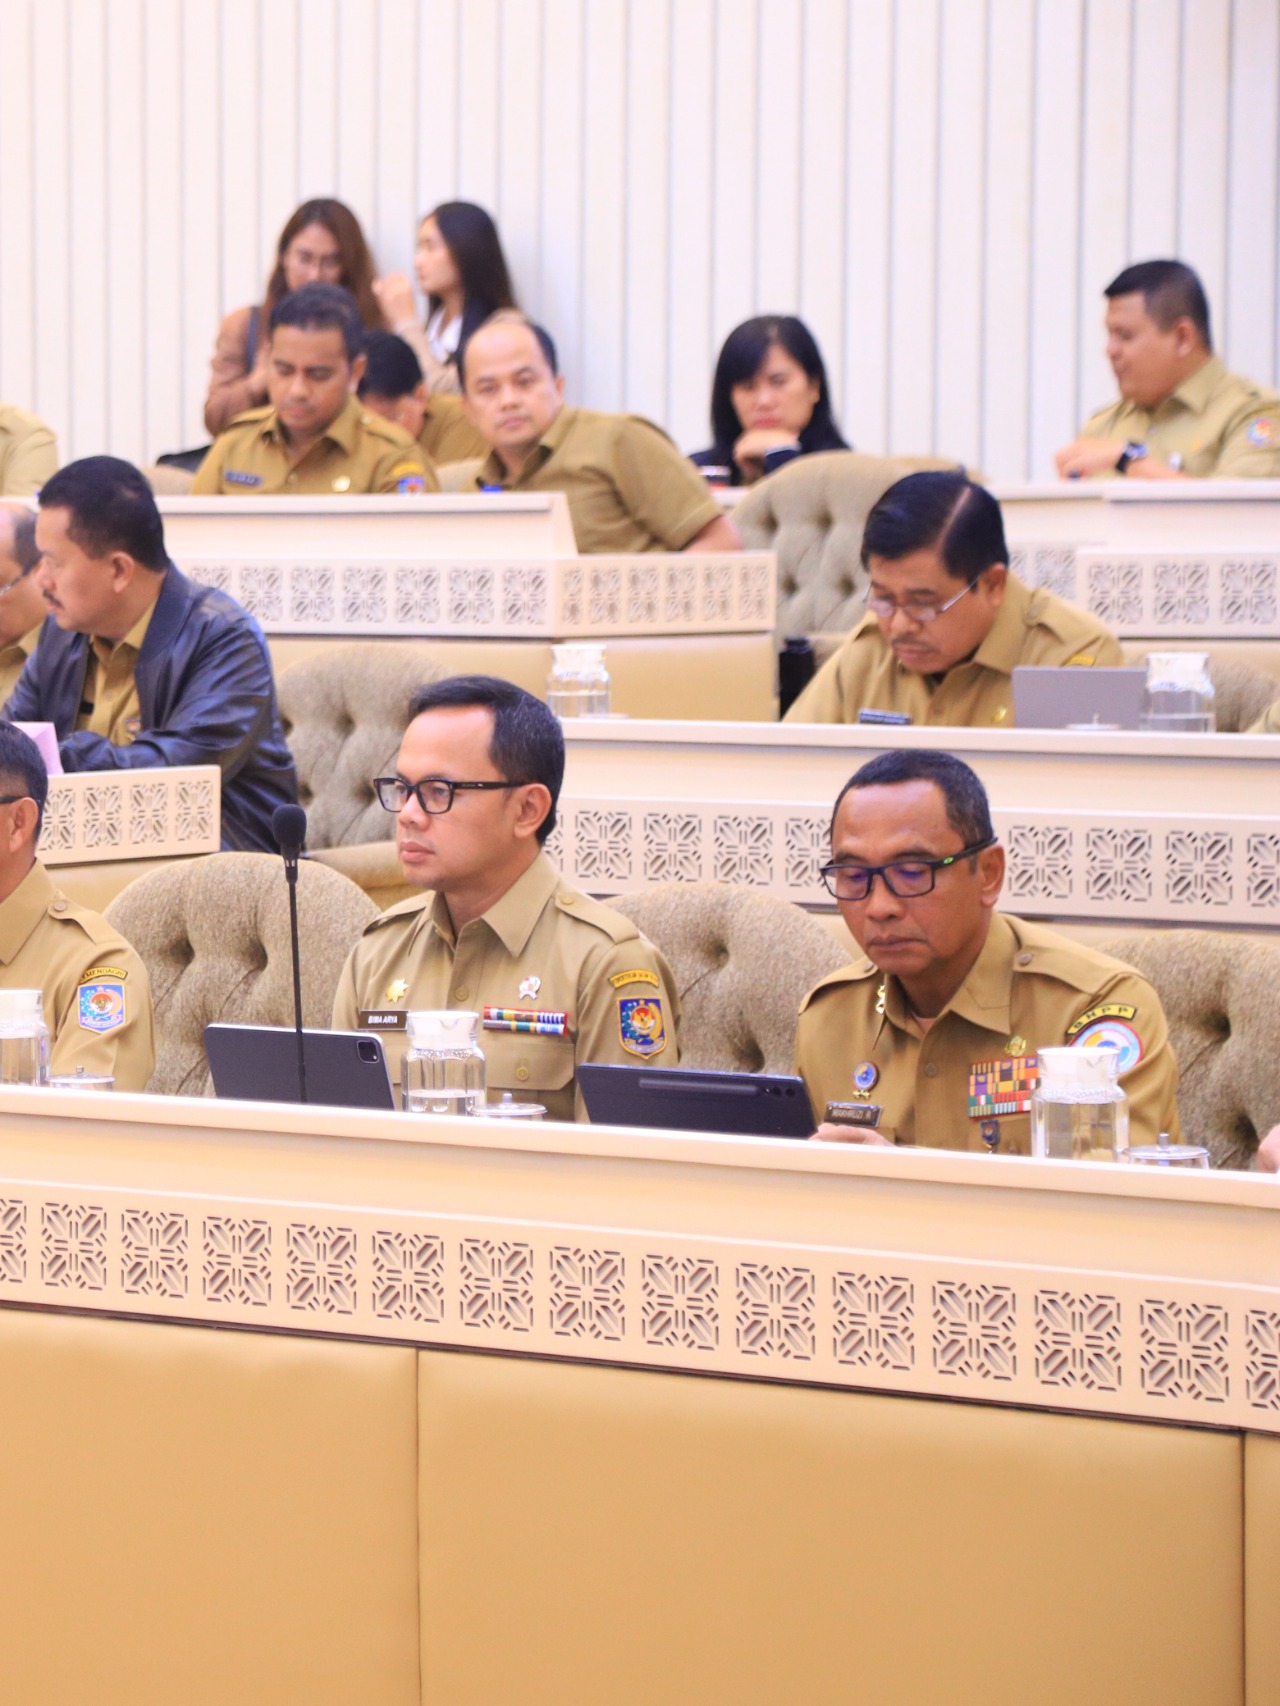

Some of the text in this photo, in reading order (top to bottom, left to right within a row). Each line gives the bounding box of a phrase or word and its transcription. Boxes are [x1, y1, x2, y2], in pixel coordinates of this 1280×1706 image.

[368, 1015, 398, 1024] BIMA ARYA
[1073, 1006, 1129, 1029] BNPP
